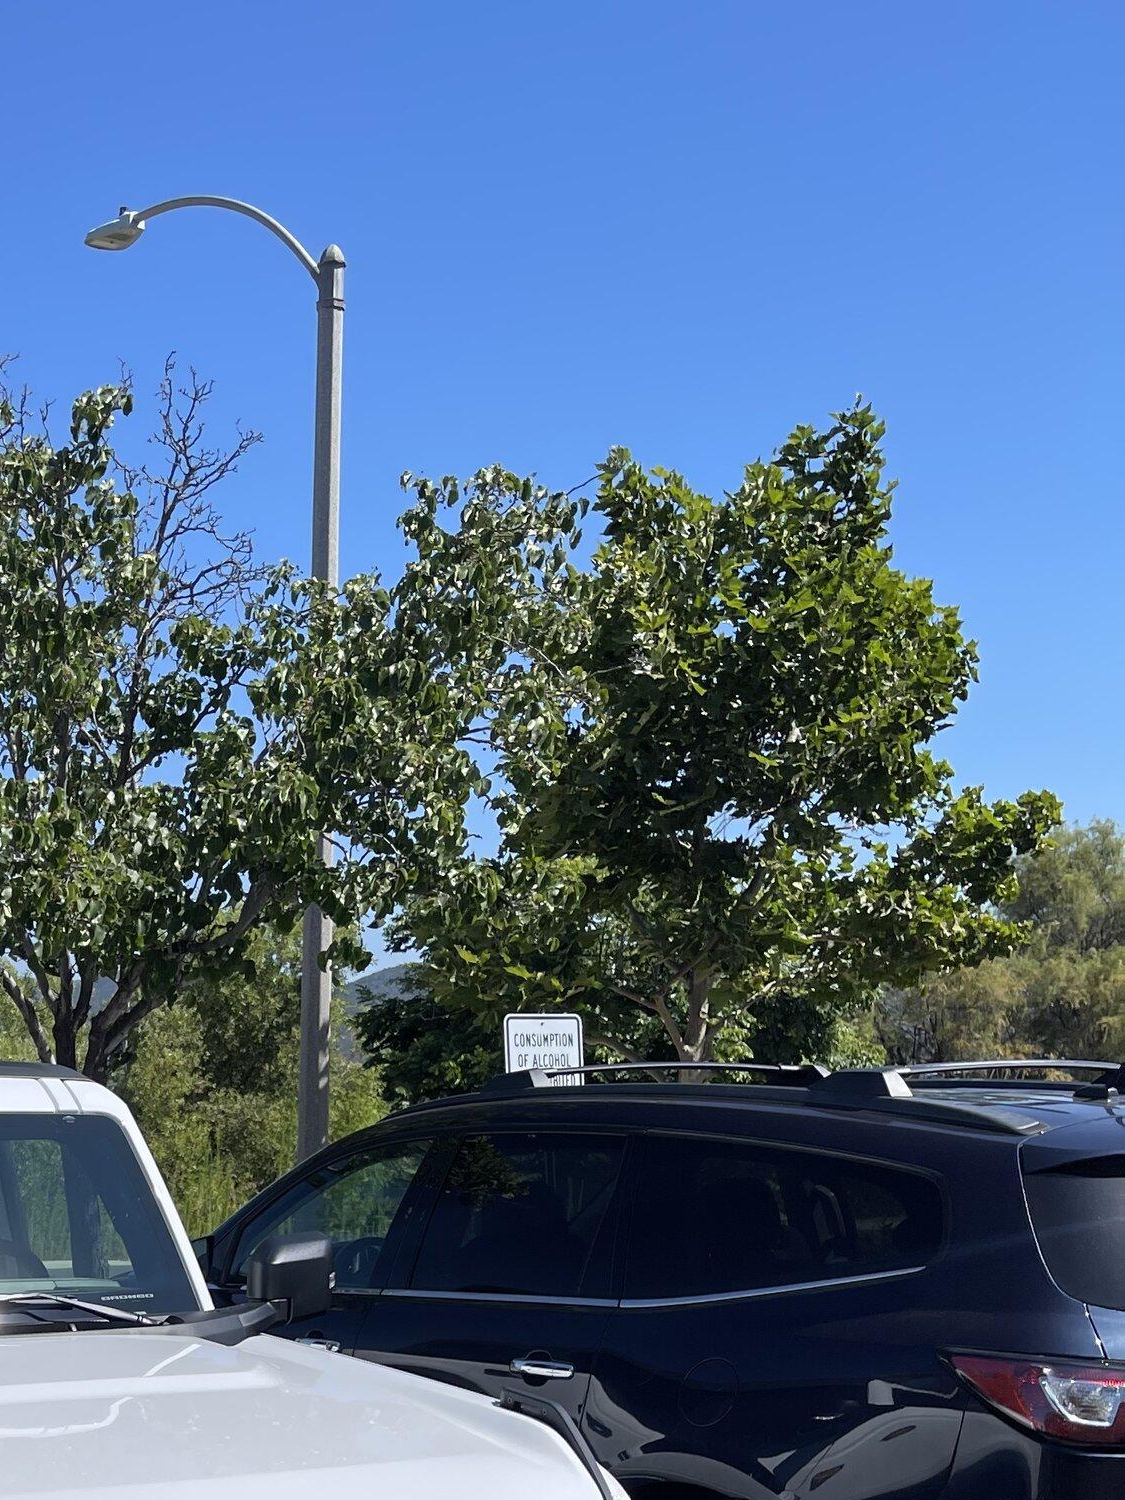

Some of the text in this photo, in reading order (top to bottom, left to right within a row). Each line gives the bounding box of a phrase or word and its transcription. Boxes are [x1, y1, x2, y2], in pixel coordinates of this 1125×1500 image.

[514, 1033, 574, 1047] CONSUMPTION
[518, 1053, 572, 1068] OF ALCOHOL
